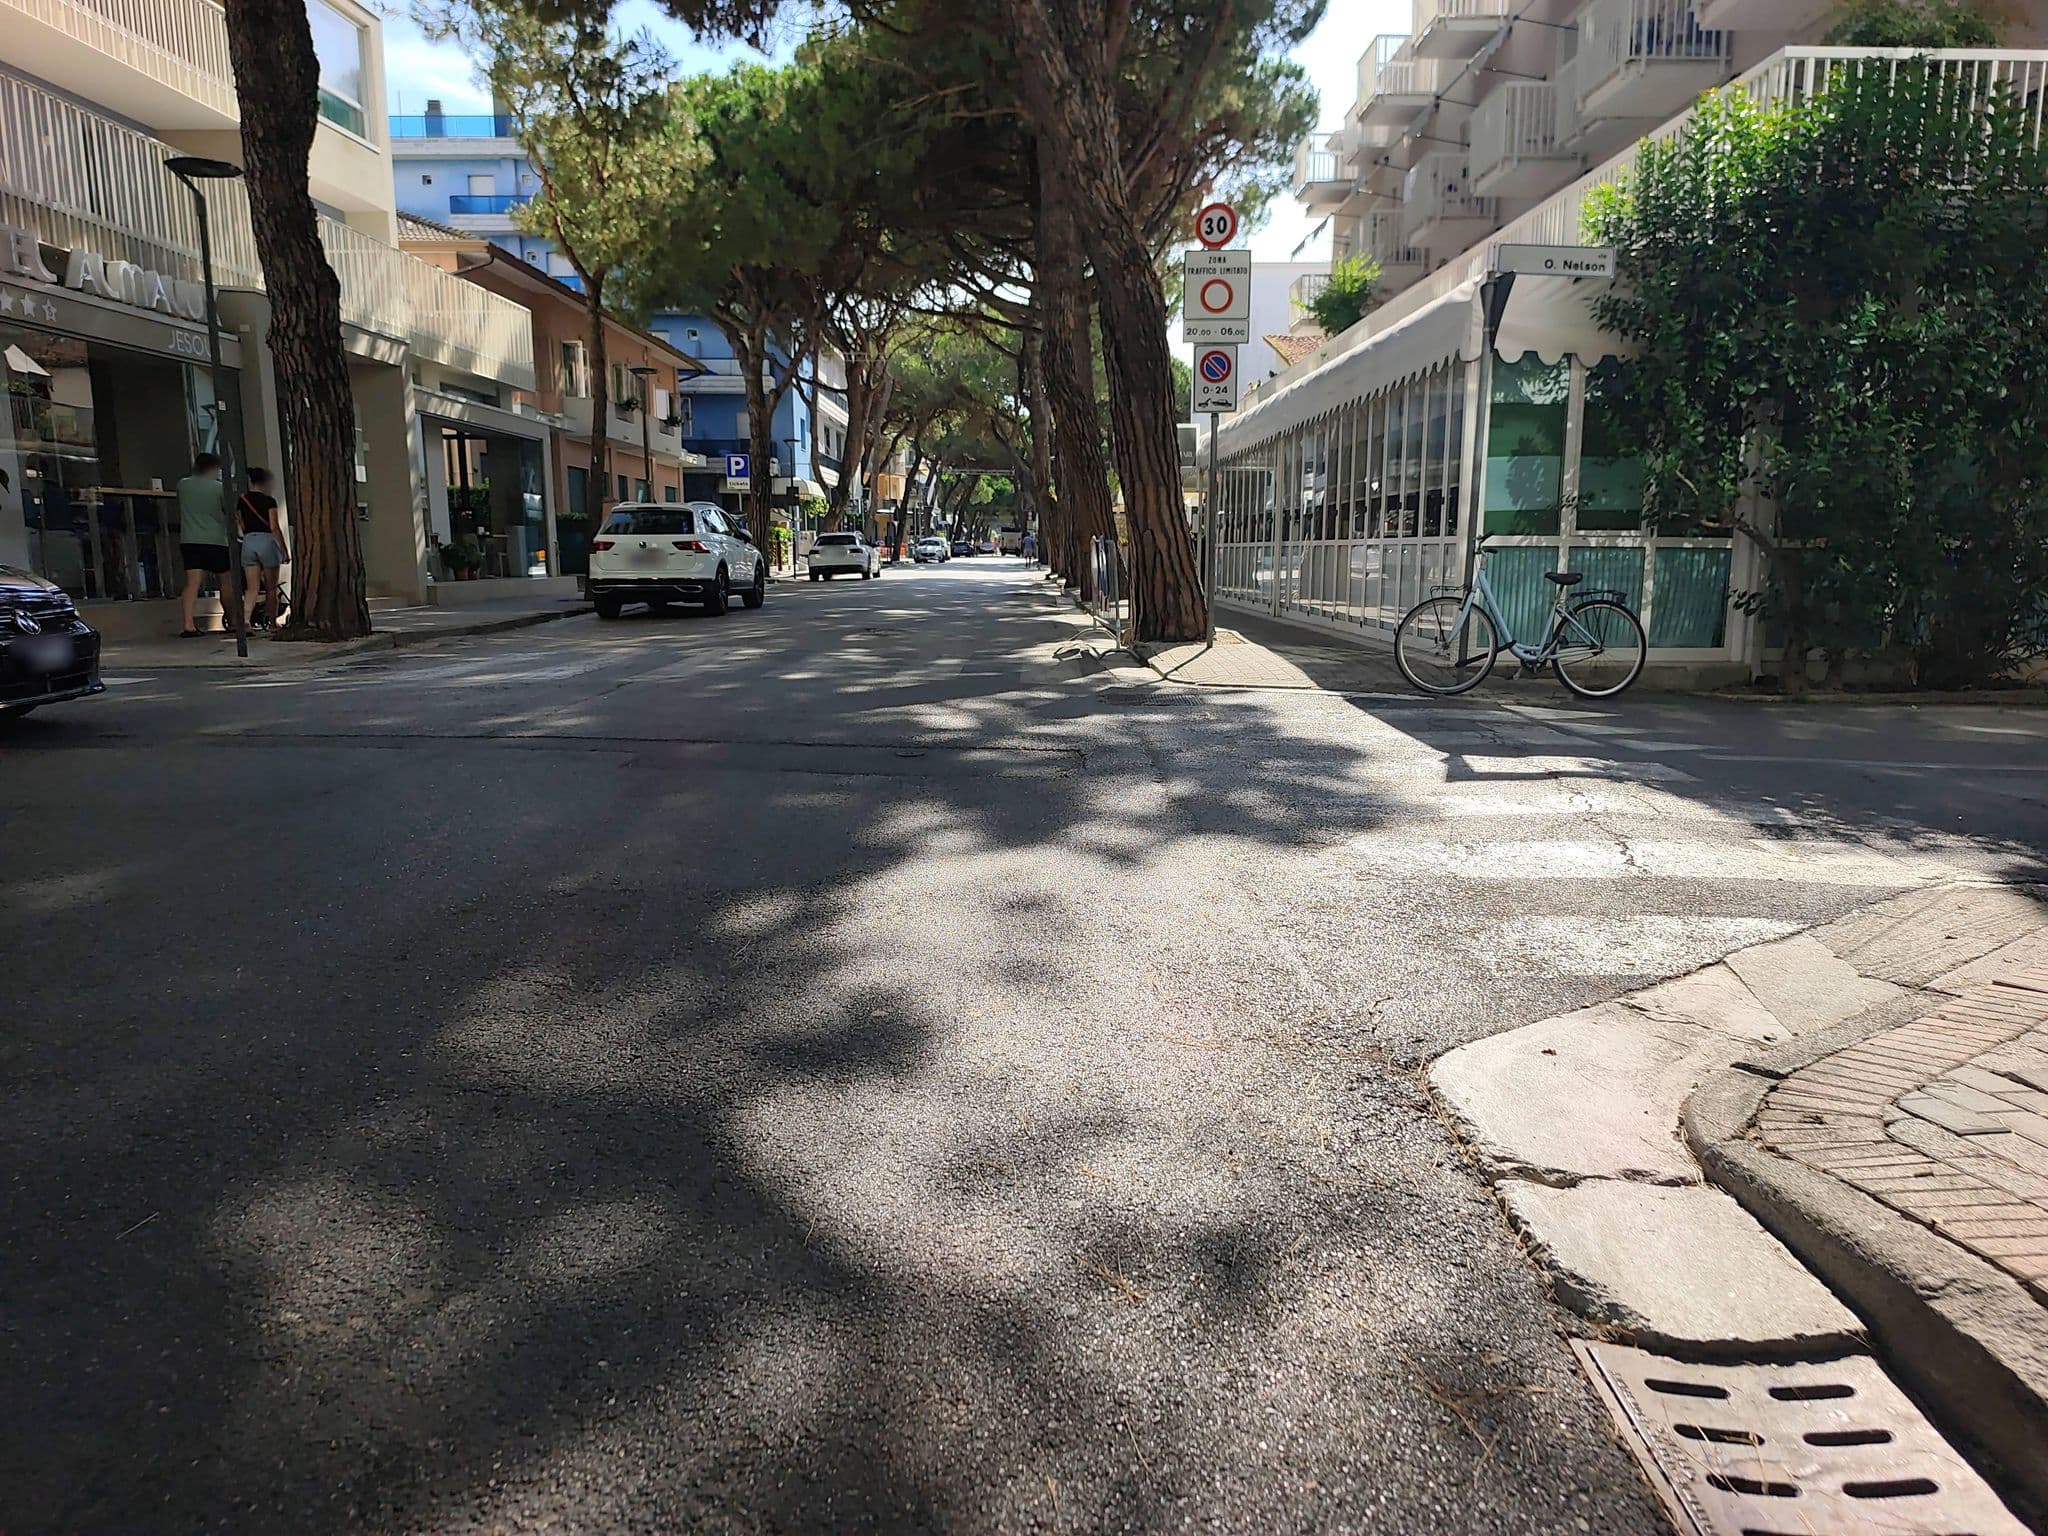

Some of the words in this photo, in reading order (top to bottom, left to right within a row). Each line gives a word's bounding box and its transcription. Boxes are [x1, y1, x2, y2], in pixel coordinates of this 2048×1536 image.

[1204, 216, 1227, 236] 30
[1208, 256, 1227, 264] ZONA
[1544, 259, 1556, 270] O.
[1563, 260, 1606, 272] Nelson
[1187, 267, 1217, 275] TRAFFICO
[1219, 267, 1248, 275] LIMITATO
[66, 248, 223, 328] ALMALU
[168, 328, 223, 360] JESOL
[730, 456, 745, 476] P
